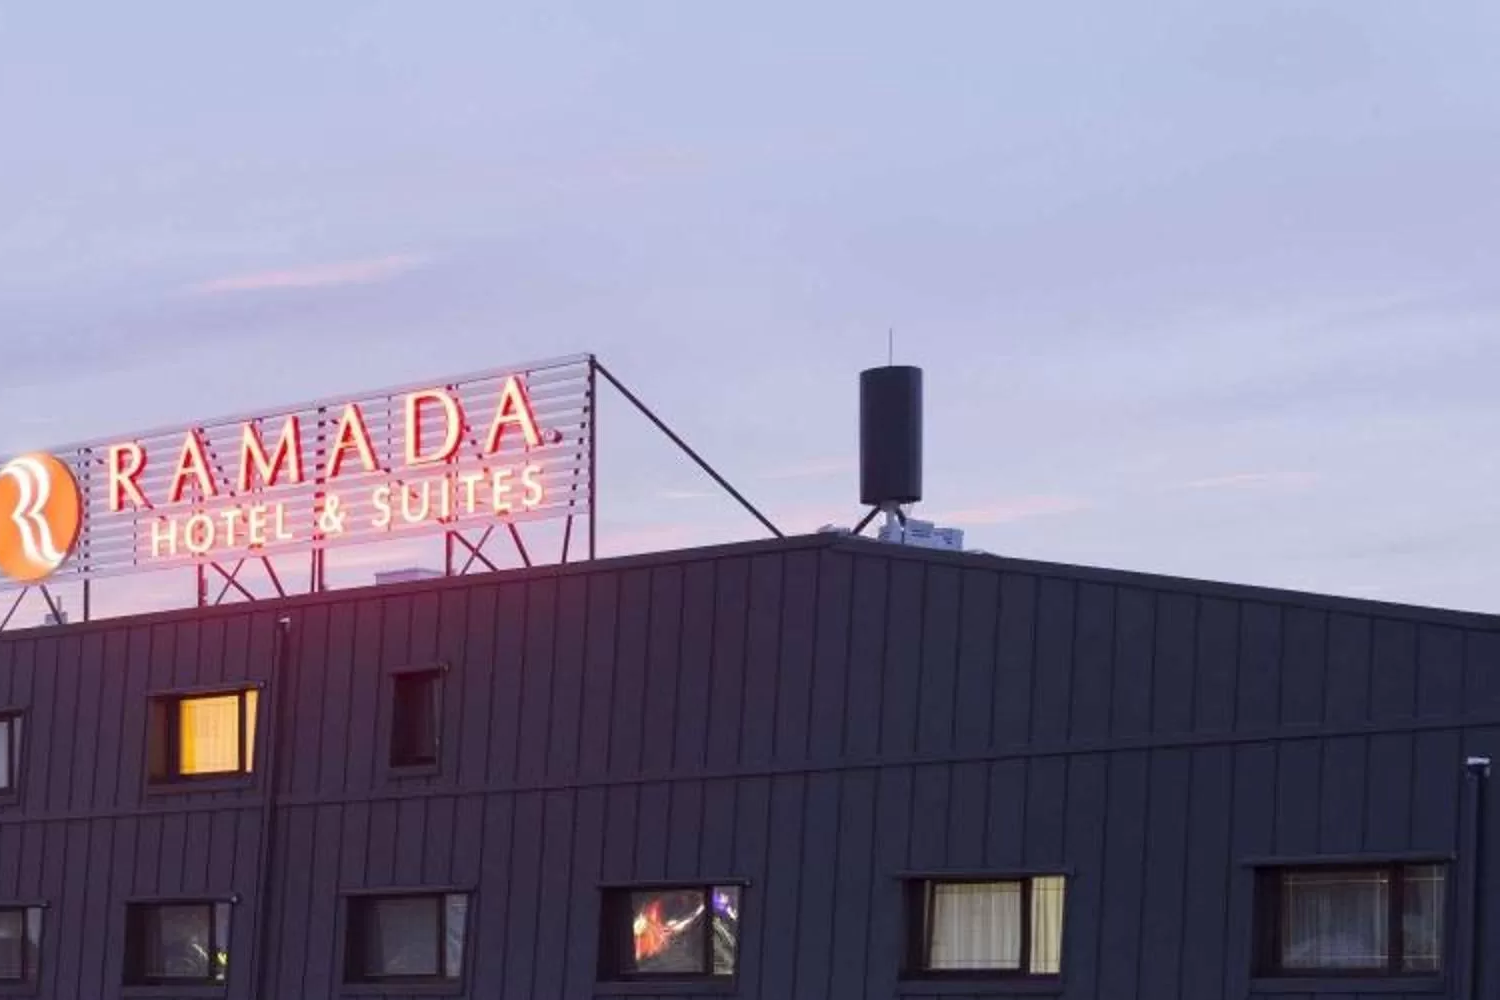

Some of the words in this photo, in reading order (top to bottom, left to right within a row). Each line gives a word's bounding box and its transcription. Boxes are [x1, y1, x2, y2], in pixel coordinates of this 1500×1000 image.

[108, 374, 545, 510] RAMADA
[152, 503, 293, 557] HOTEL
[319, 495, 346, 533] &
[372, 464, 543, 529] SUITES
